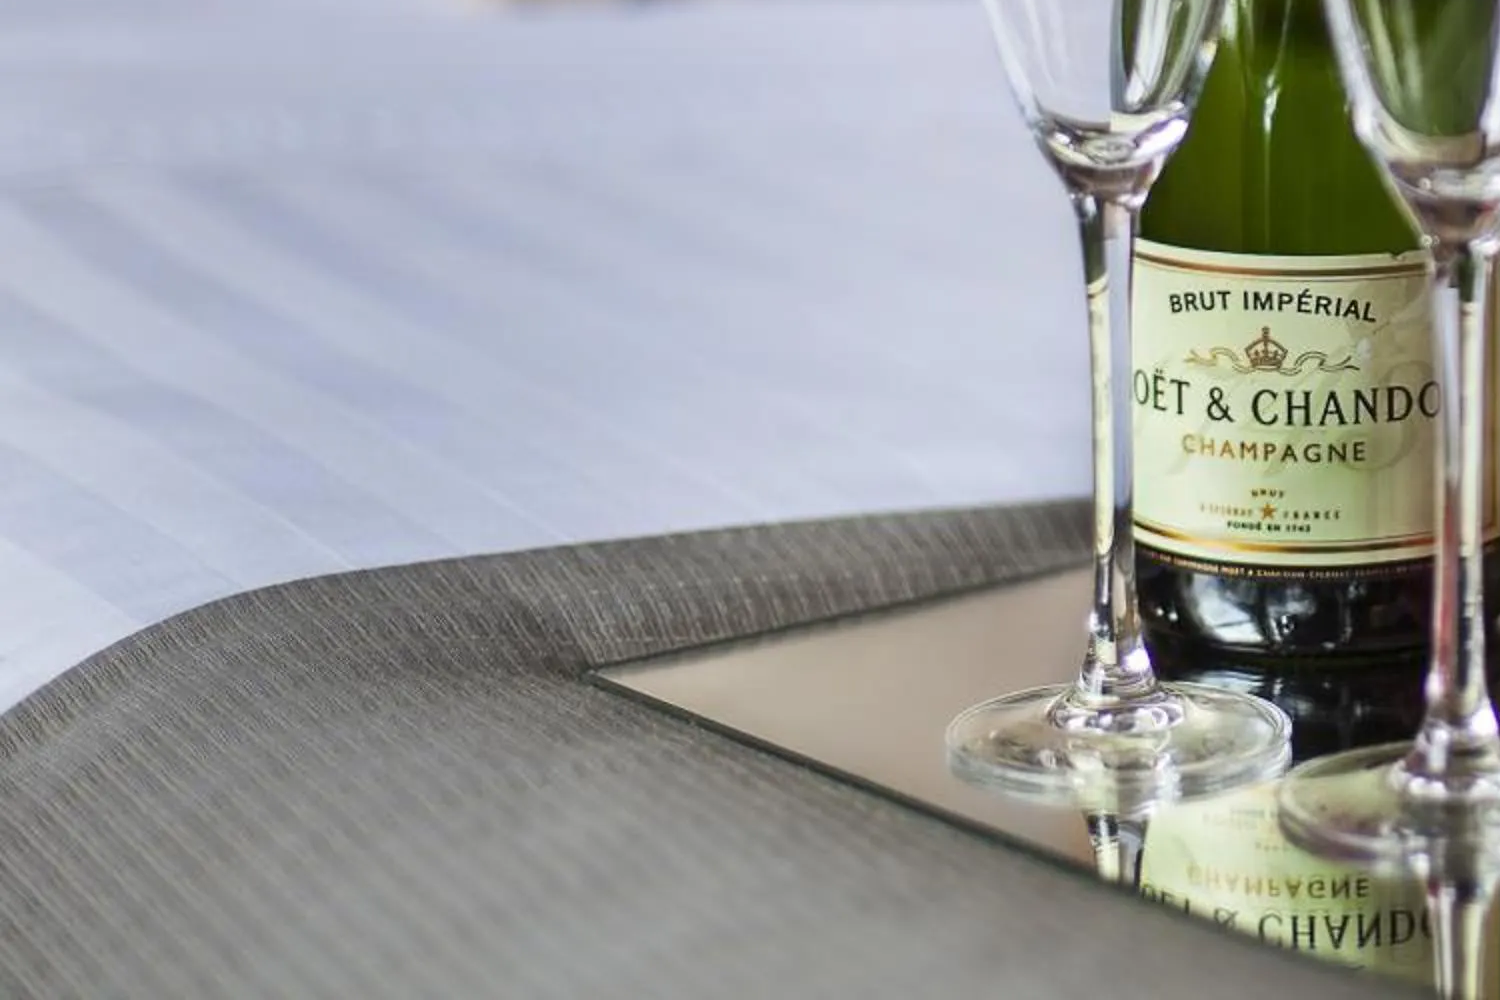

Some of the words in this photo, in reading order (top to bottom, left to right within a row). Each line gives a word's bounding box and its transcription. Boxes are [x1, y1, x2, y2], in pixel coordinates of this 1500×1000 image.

[1169, 290, 1231, 314] BRUT
[1243, 288, 1377, 322] IMPÉRIAL
[1133, 368, 1190, 415] OËT
[1206, 386, 1234, 422] &
[1251, 380, 1442, 427] CHANDO
[1182, 434, 1367, 463] CHAMPAGNE
